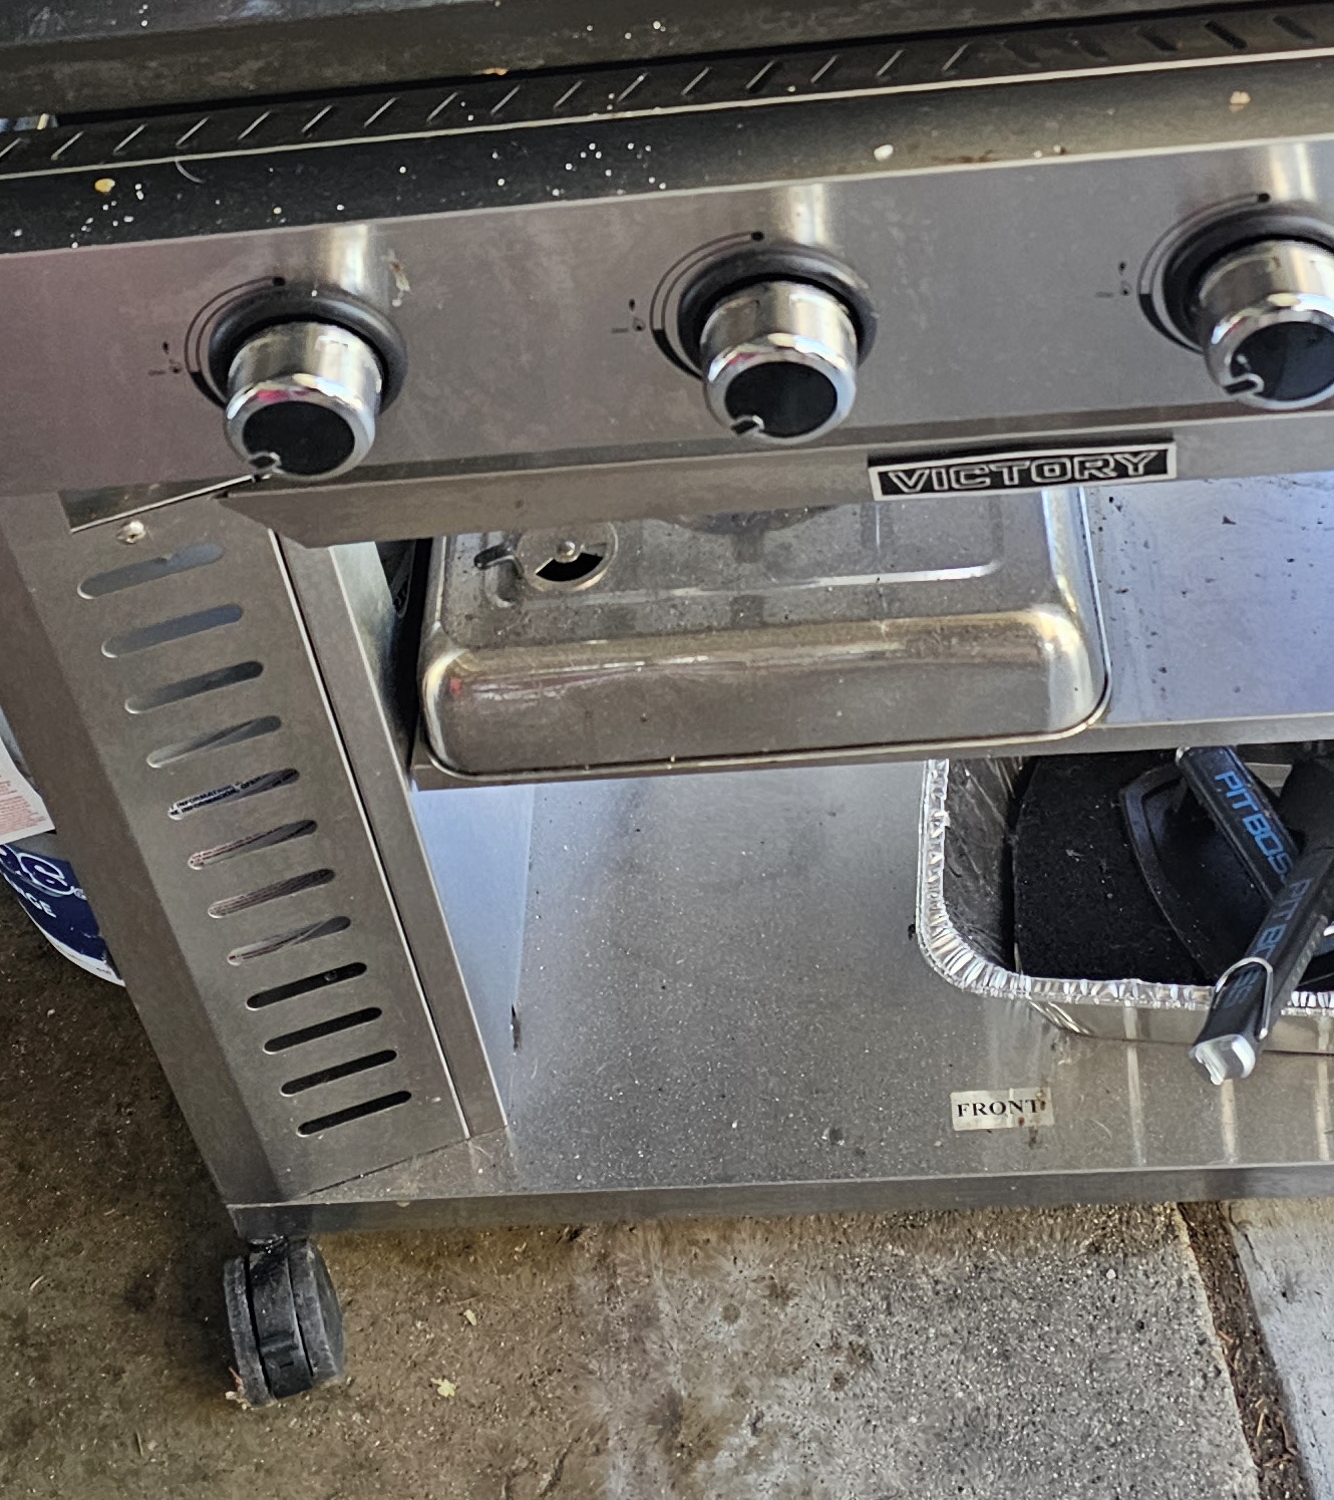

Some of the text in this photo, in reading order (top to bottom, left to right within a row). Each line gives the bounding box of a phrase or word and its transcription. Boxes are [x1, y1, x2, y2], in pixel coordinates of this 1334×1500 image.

[887, 451, 1159, 493] VICTORY
[1214, 769, 1295, 884] PIT BOS
[1272, 876, 1314, 922] PIT
[956, 1099, 1038, 1117] FRONT
